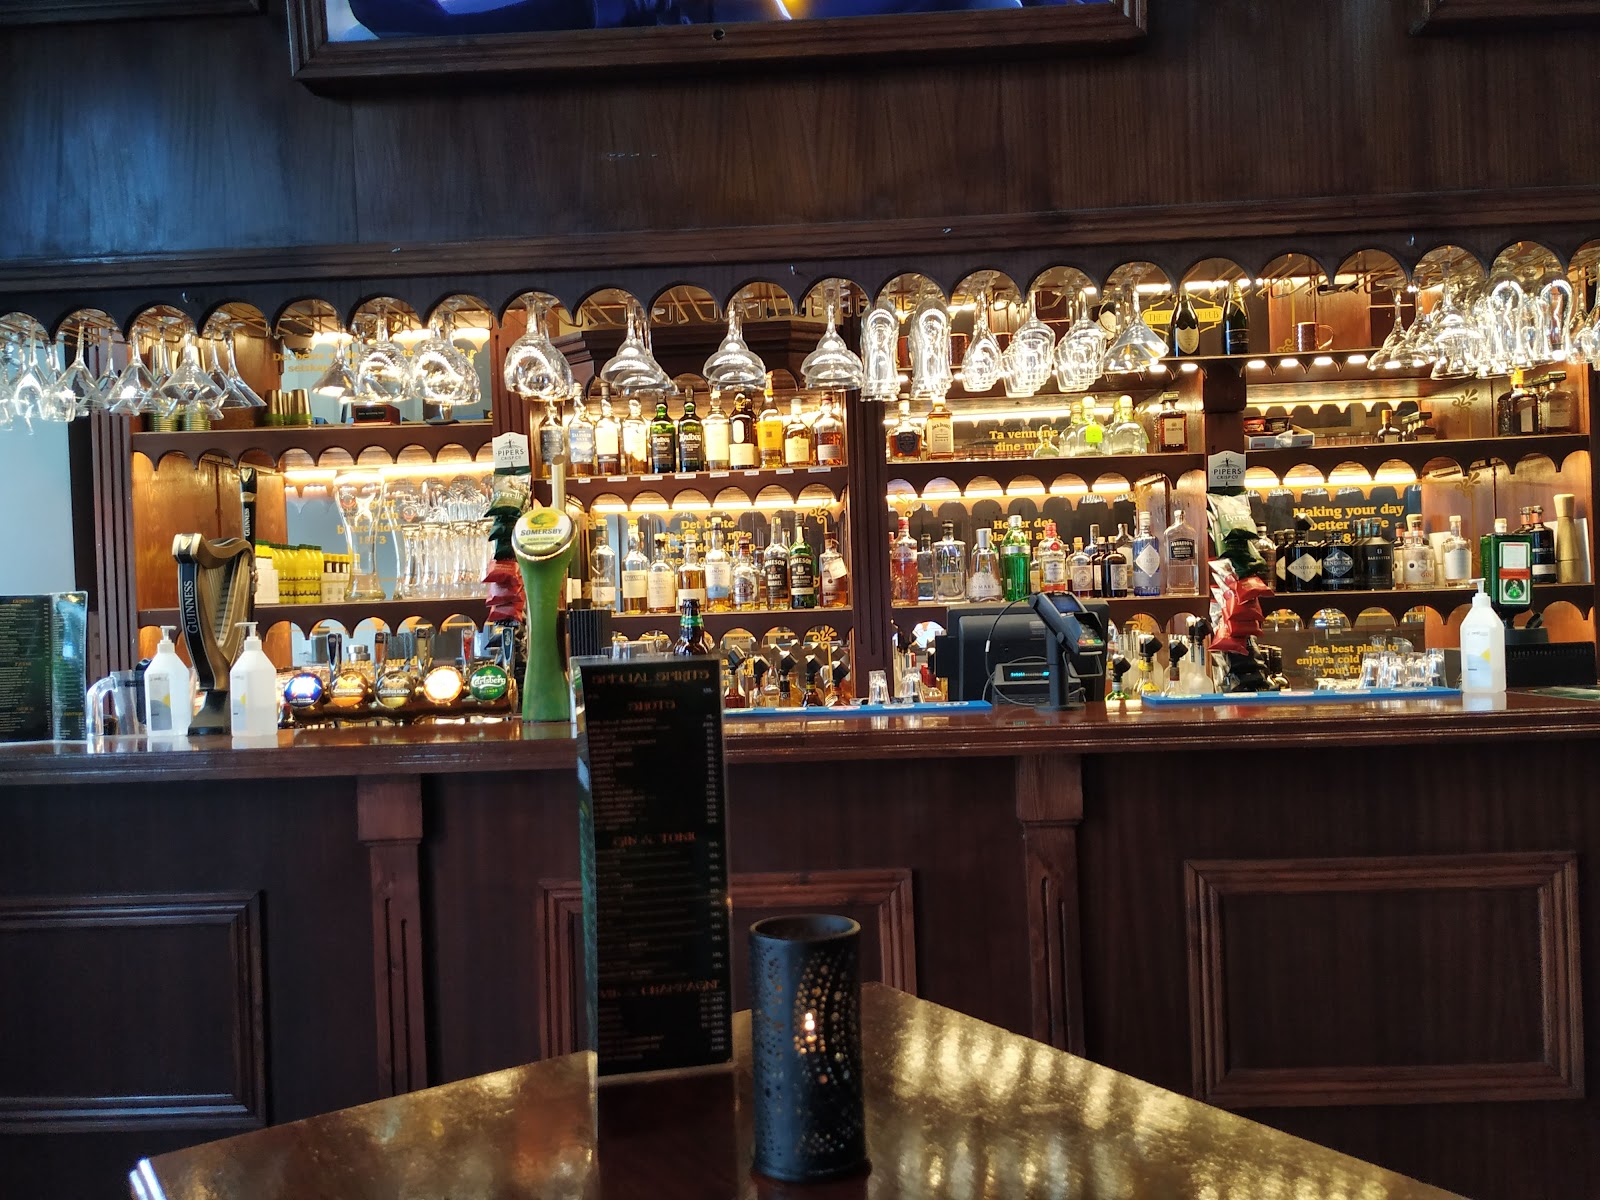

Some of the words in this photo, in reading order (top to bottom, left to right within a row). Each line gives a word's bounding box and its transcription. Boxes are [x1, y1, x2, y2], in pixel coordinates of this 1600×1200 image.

[989, 430, 1004, 439] Ta
[1007, 429, 1058, 439] vennene
[994, 442, 1021, 452] dine
[497, 449, 525, 457] PIPERS
[1293, 506, 1342, 519] Making
[1345, 506, 1377, 519] your
[1380, 503, 1404, 516] day
[681, 520, 701, 529] Det
[704, 519, 735, 529] bste
[1034, 518, 1054, 527] det
[1309, 518, 1350, 531] better
[520, 528, 562, 536] SOMERSBY
[183, 580, 198, 634] GUINNESS
[1308, 646, 1329, 654] The
[1331, 645, 1354, 653] best
[1356, 644, 1385, 655] place
[1296, 656, 1325, 667] enjoy
[1337, 655, 1359, 664] cold
[1322, 667, 1347, 677] your
[472, 675, 506, 688] Carlsberg
